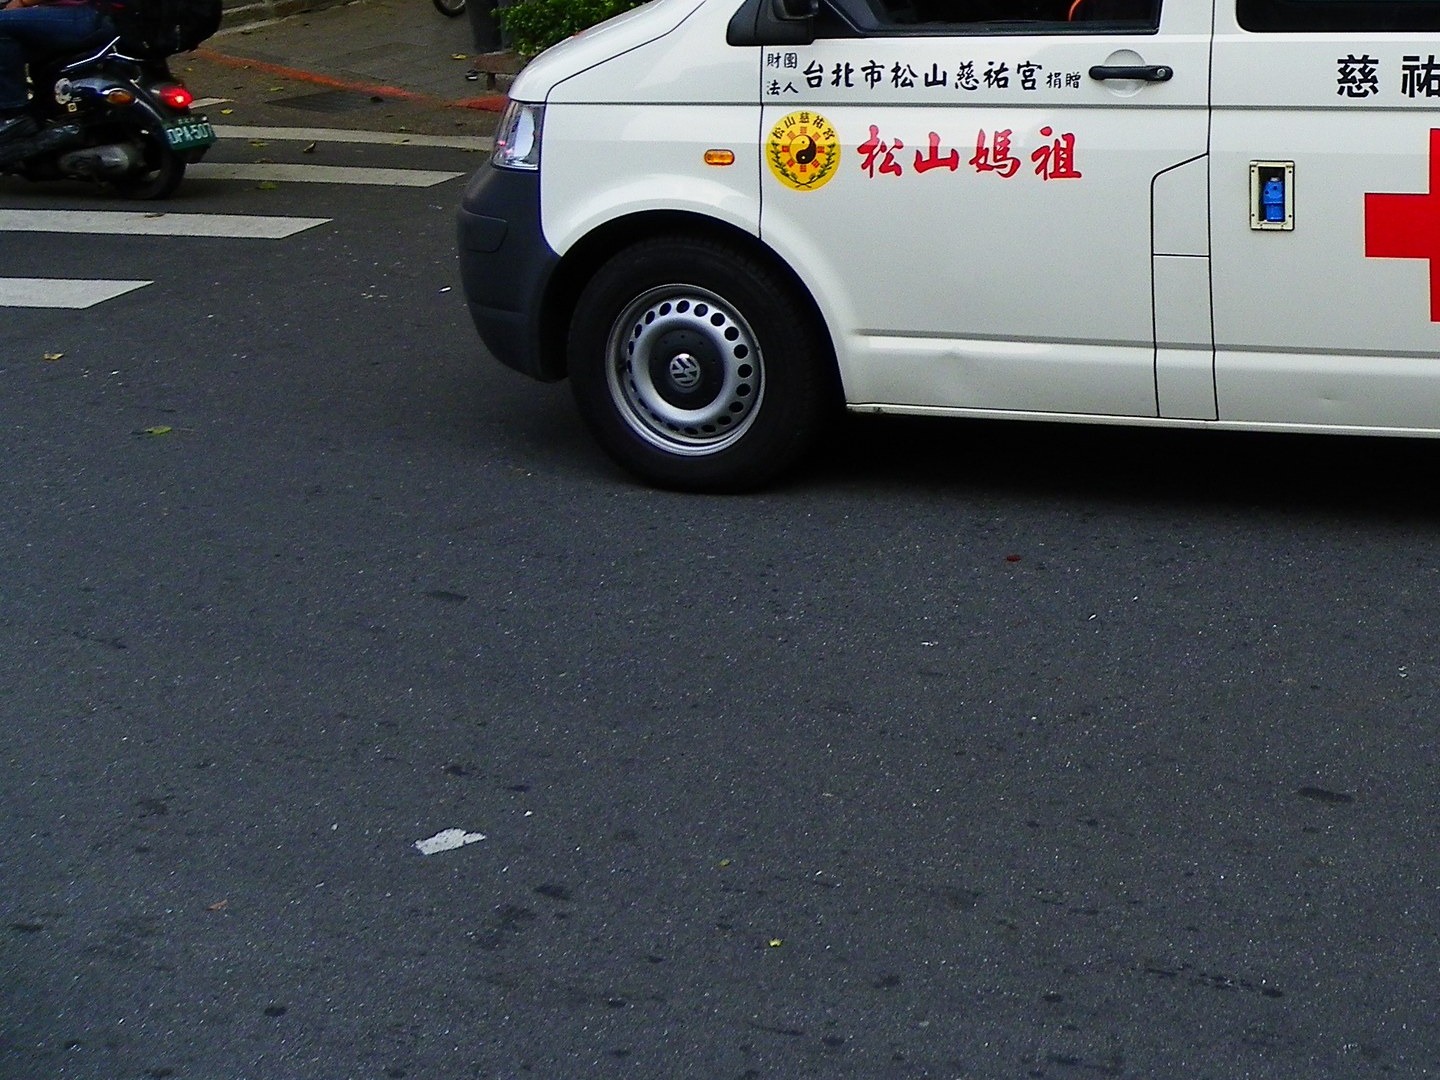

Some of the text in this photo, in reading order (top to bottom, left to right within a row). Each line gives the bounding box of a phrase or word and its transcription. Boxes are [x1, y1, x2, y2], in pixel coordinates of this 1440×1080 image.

[767, 52, 799, 69] 財團
[766, 80, 799, 96] 法人
[802, 58, 1082, 93] 台北市松山慈祐宮 捐贈
[856, 122, 1083, 182] 松山媽祖
